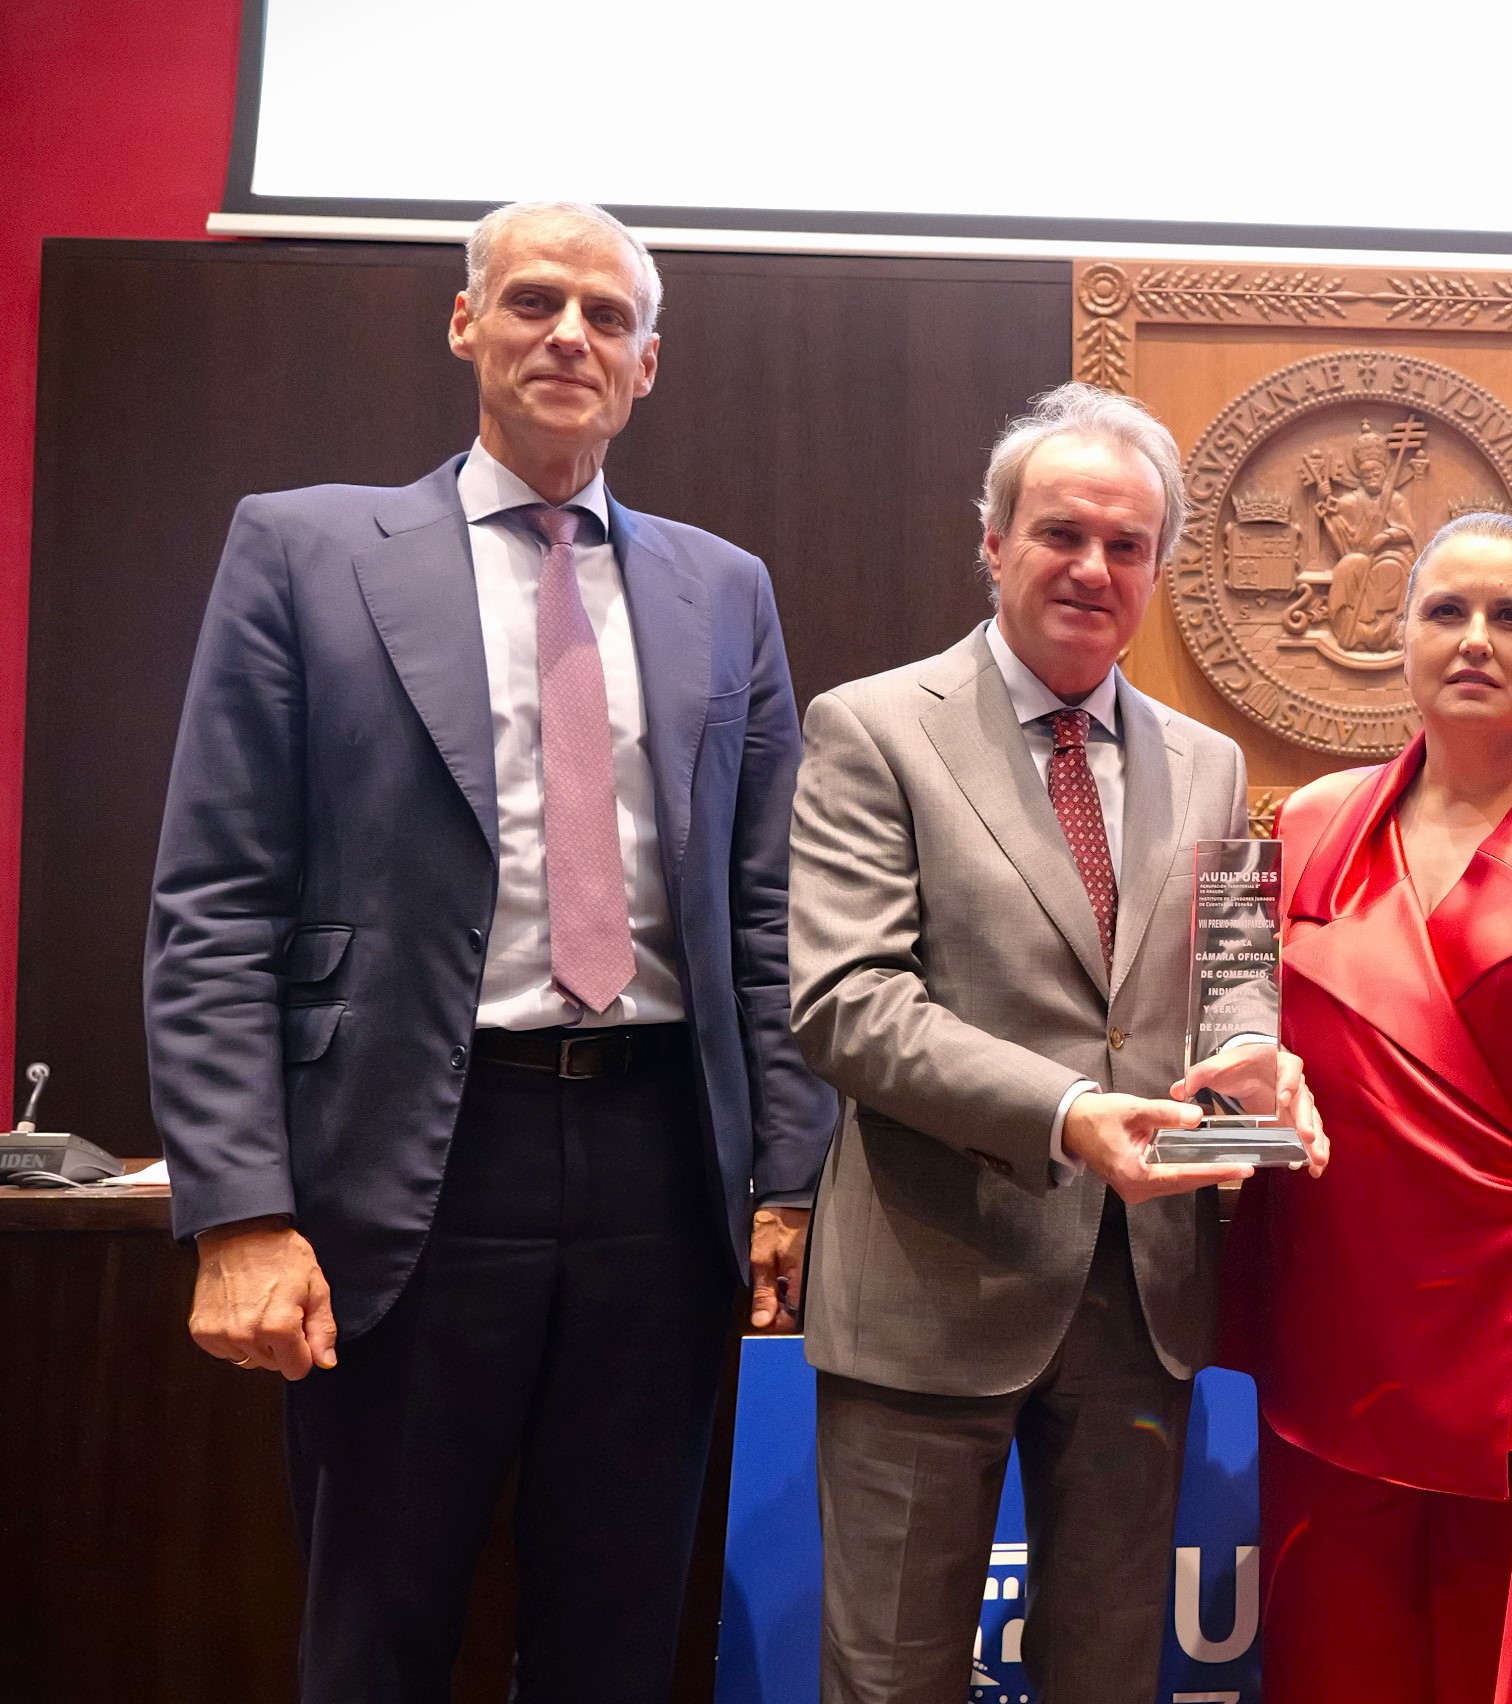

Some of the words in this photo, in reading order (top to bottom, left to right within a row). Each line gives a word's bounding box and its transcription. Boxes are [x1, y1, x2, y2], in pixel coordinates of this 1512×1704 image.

[1199, 871, 1277, 882] AUDITORES
[1208, 919, 1229, 929] PREMIO
[1195, 951, 1235, 961] CÁMARA
[1237, 952, 1276, 961] OFICIAL
[1200, 970, 1214, 979] DE
[1216, 970, 1269, 980] COMERCIO,
[1203, 1005, 1210, 1013] Y
[1199, 1023, 1213, 1031] DE
